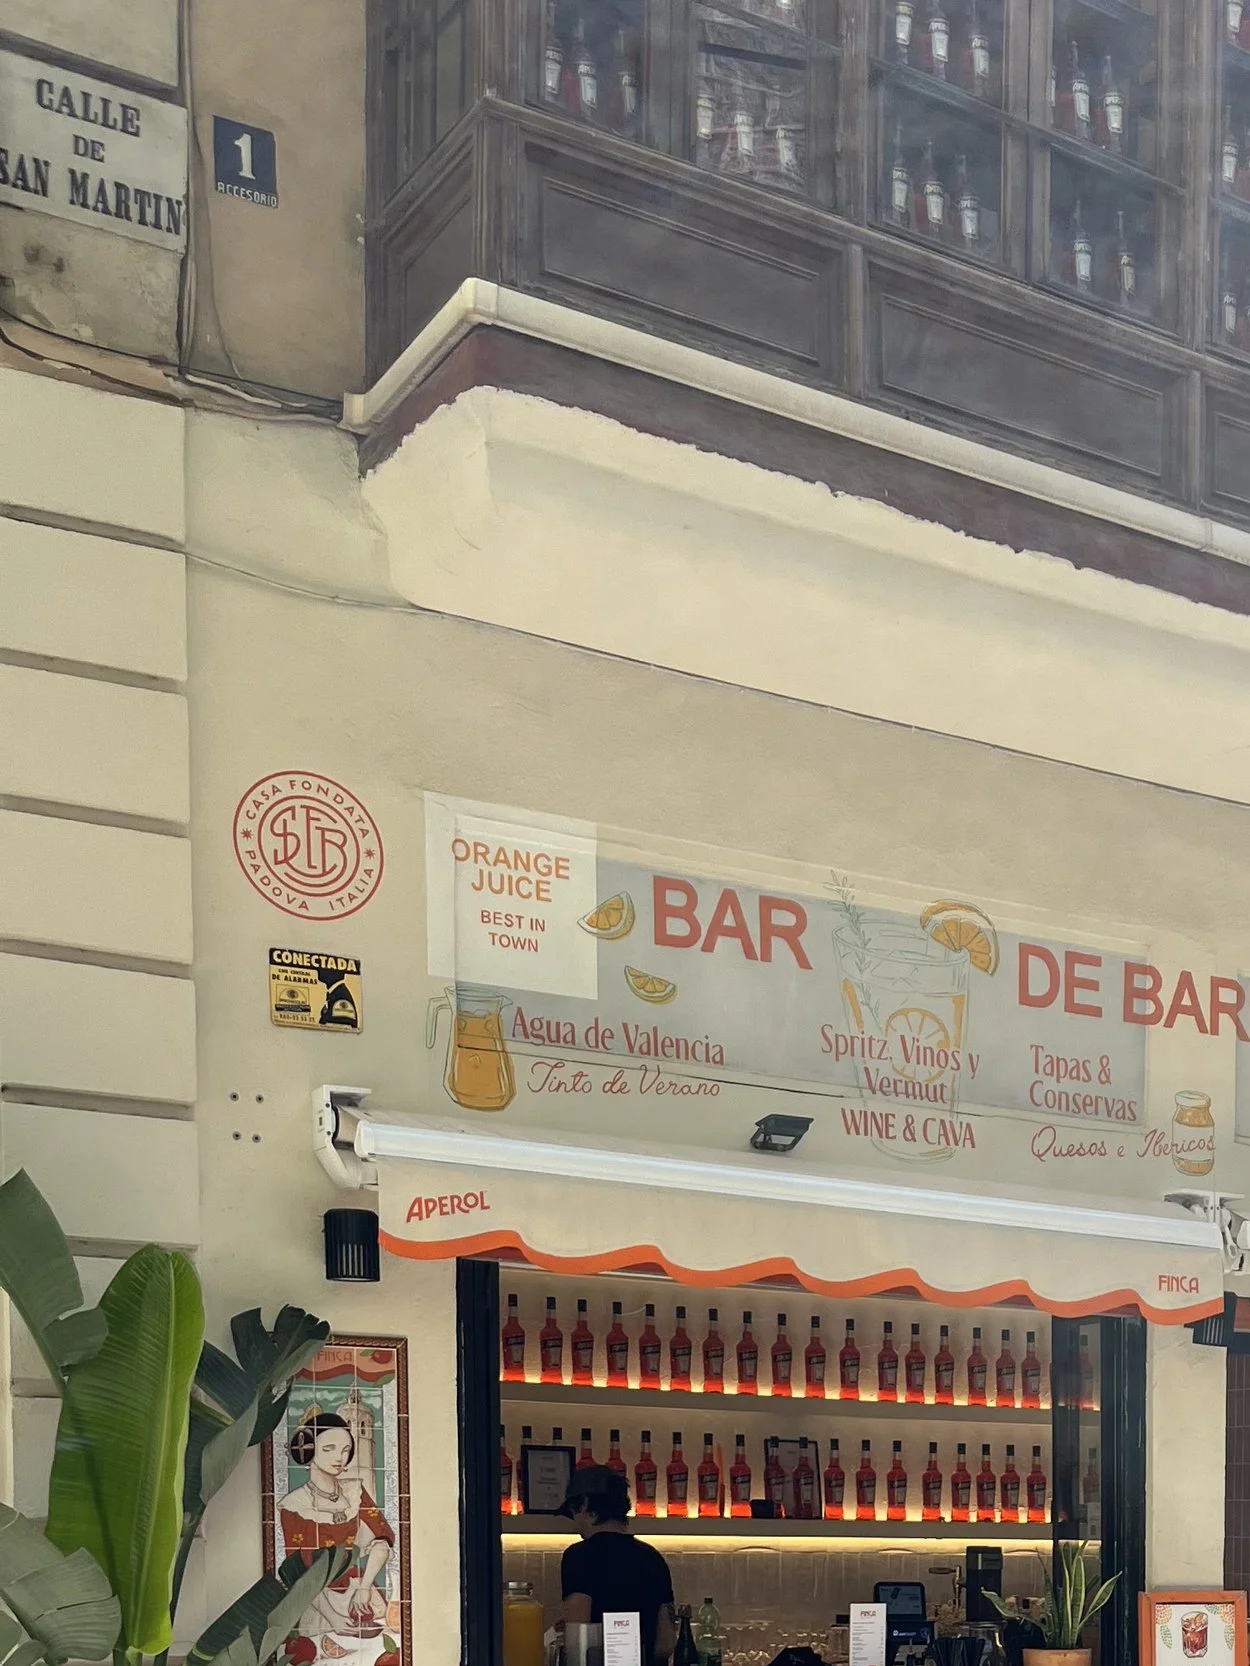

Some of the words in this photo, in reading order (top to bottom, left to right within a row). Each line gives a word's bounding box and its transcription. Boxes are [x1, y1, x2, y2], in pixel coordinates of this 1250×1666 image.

[36, 78, 140, 137] CALLE
[73, 134, 105, 163] DE
[234, 133, 256, 179] 1
[69, 168, 182, 235] MARTIN
[217, 182, 277, 207] ACCESORIO
[246, 784, 282, 820] CASA
[290, 780, 370, 838] FONDATA
[452, 838, 570, 881] ORANGE
[245, 850, 309, 911] PADOVA
[329, 868, 374, 910] ITALIA
[471, 868, 553, 903] JUICE
[481, 909, 524, 930] BEST
[529, 914, 546, 932] IN
[653, 874, 813, 970] BAR
[273, 950, 357, 972] CONECTADA
[488, 932, 539, 953] TOWN
[284, 975, 317, 985] ALARMAS
[1018, 942, 1102, 1018] DE
[511, 1006, 577, 1046] Agua
[584, 1017, 615, 1051] de
[622, 1022, 725, 1065] Valencia
[899, 1033, 961, 1071] Vinos
[968, 1052, 980, 1079] y
[1030, 1045, 1092, 1084] Tapas
[1097, 1054, 1112, 1085] &
[527, 1061, 592, 1095] Tinto
[602, 1069, 632, 1095] de
[639, 1064, 721, 1096] Verano
[863, 1066, 947, 1104] Vermut
[1029, 1080, 1138, 1122] Conservas
[840, 1107, 896, 1140] WINE
[902, 1117, 917, 1143] &
[923, 1116, 976, 1148] CAVA
[1031, 1125, 1107, 1162] Quesos
[406, 1189, 491, 1223] APEROL
[1158, 1274, 1199, 1294] FINCA
[317, 1351, 352, 1361] FINCA
